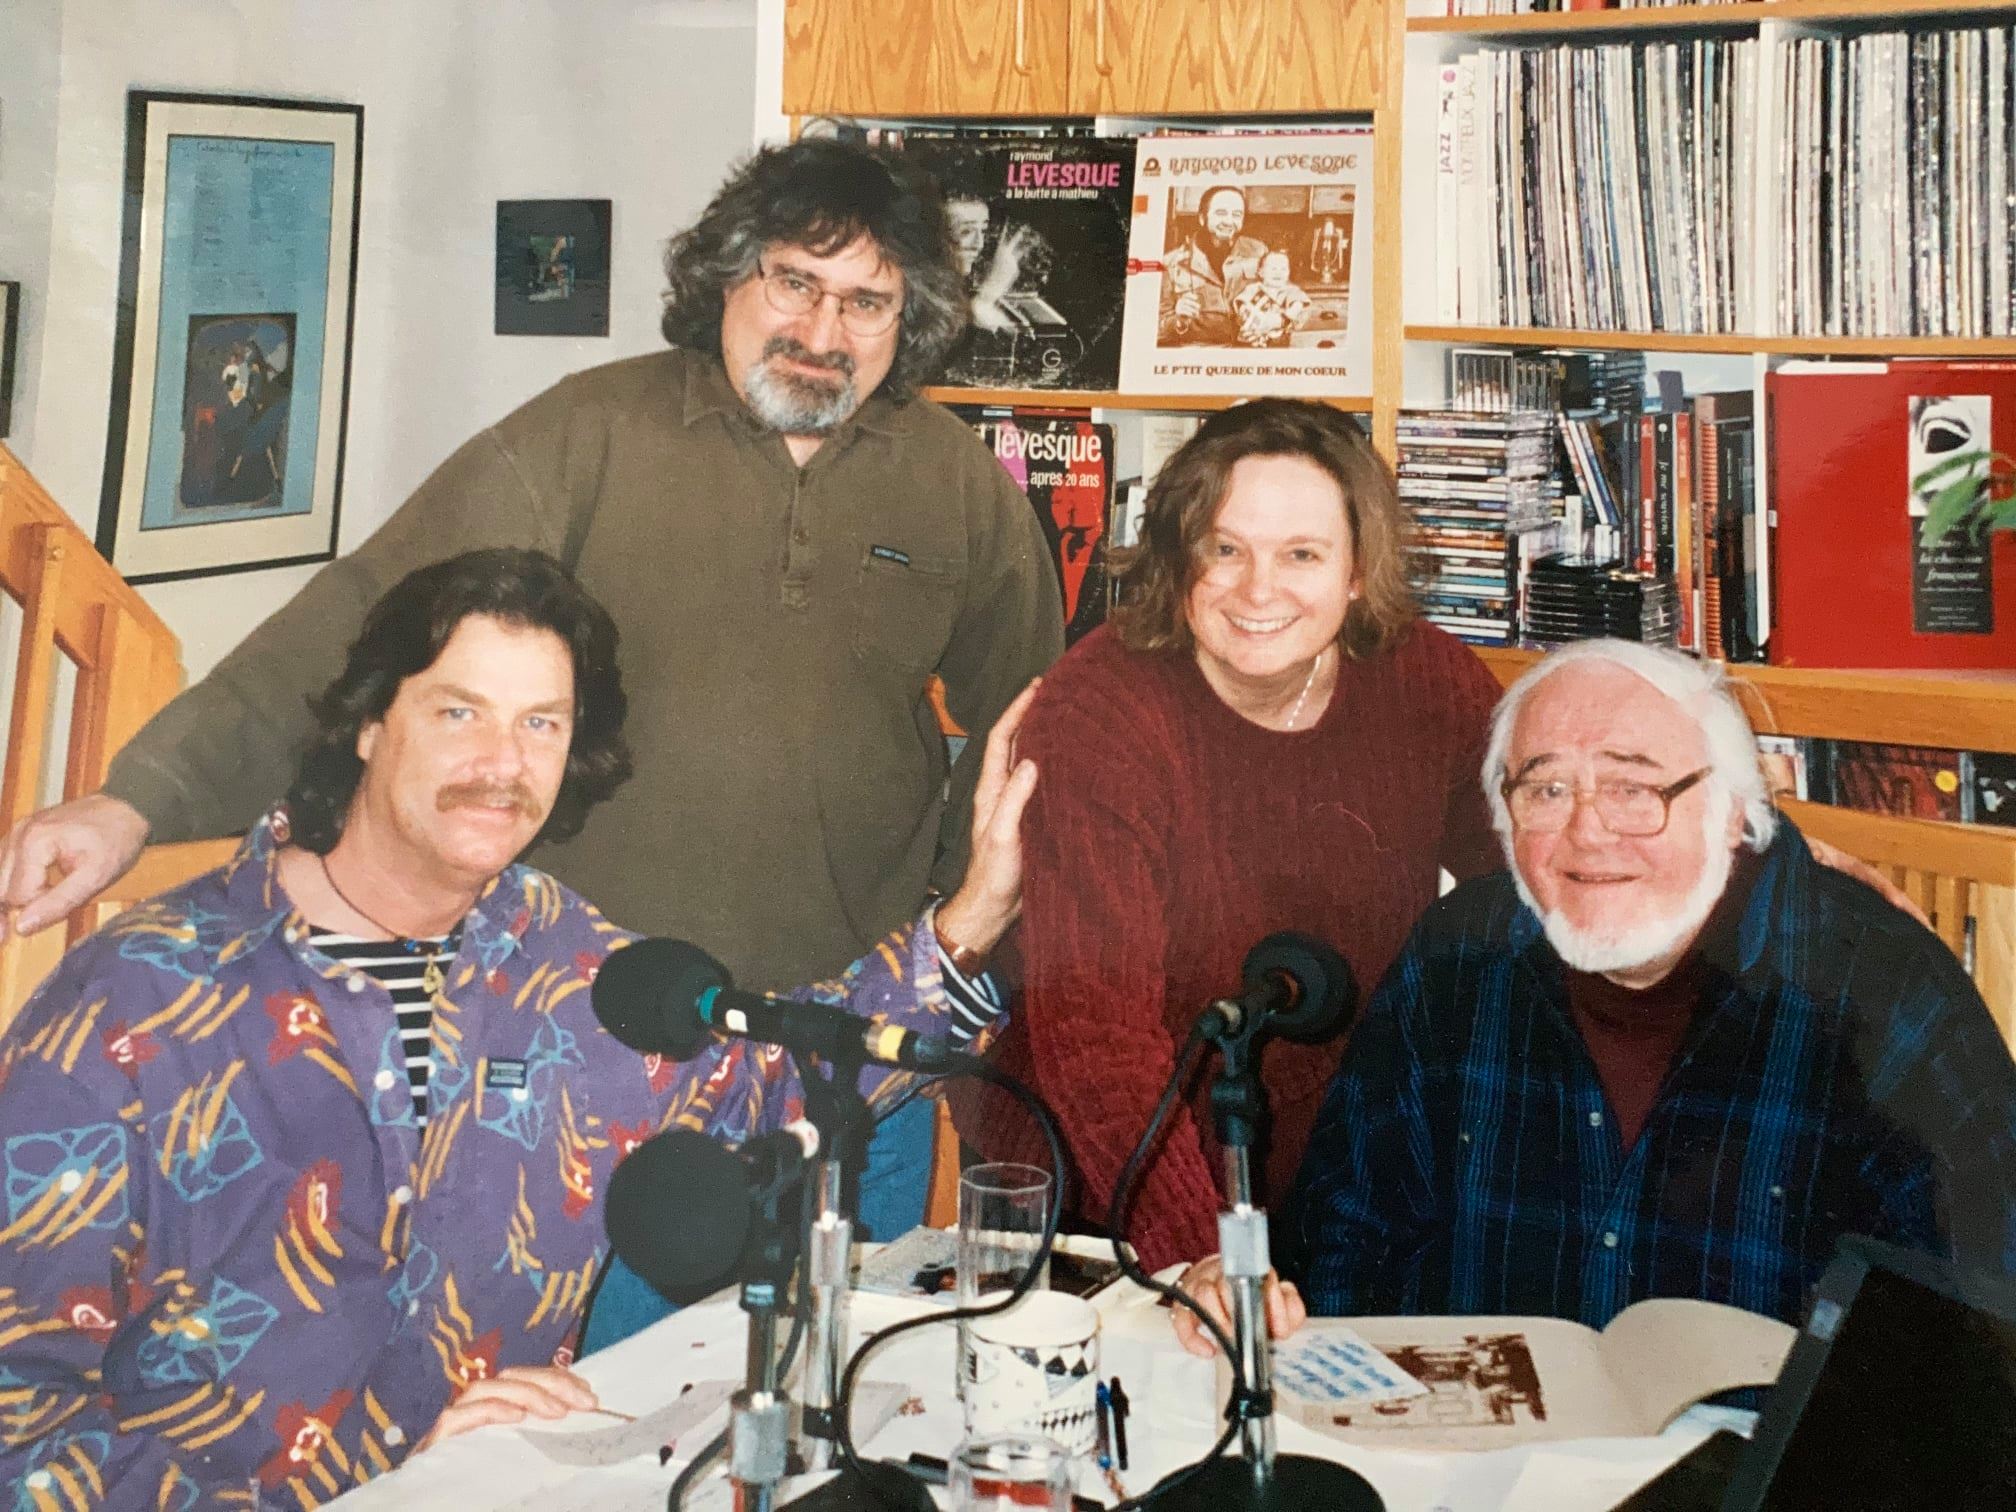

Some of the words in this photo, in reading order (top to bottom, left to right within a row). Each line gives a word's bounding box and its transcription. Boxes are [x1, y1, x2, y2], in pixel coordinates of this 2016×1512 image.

[1009, 150, 1054, 163] raymond
[1440, 133, 1453, 173] JAZZ
[1169, 157, 1257, 175] RAYMOND
[1264, 154, 1358, 175] LEVESQUE
[1007, 163, 1121, 187] LEVESQUE
[1014, 187, 1023, 199] la
[1024, 187, 1050, 199] butte
[1059, 187, 1098, 199] mathieu
[1154, 365, 1169, 375] LE
[1172, 365, 1202, 375] P'TIT
[1205, 365, 1253, 377] QUEBEC
[1256, 366, 1274, 376] DE
[1275, 366, 1301, 376] MON
[1304, 366, 1347, 377] COEUR
[1065, 474, 1077, 486] 20
[1079, 474, 1101, 488] ans
